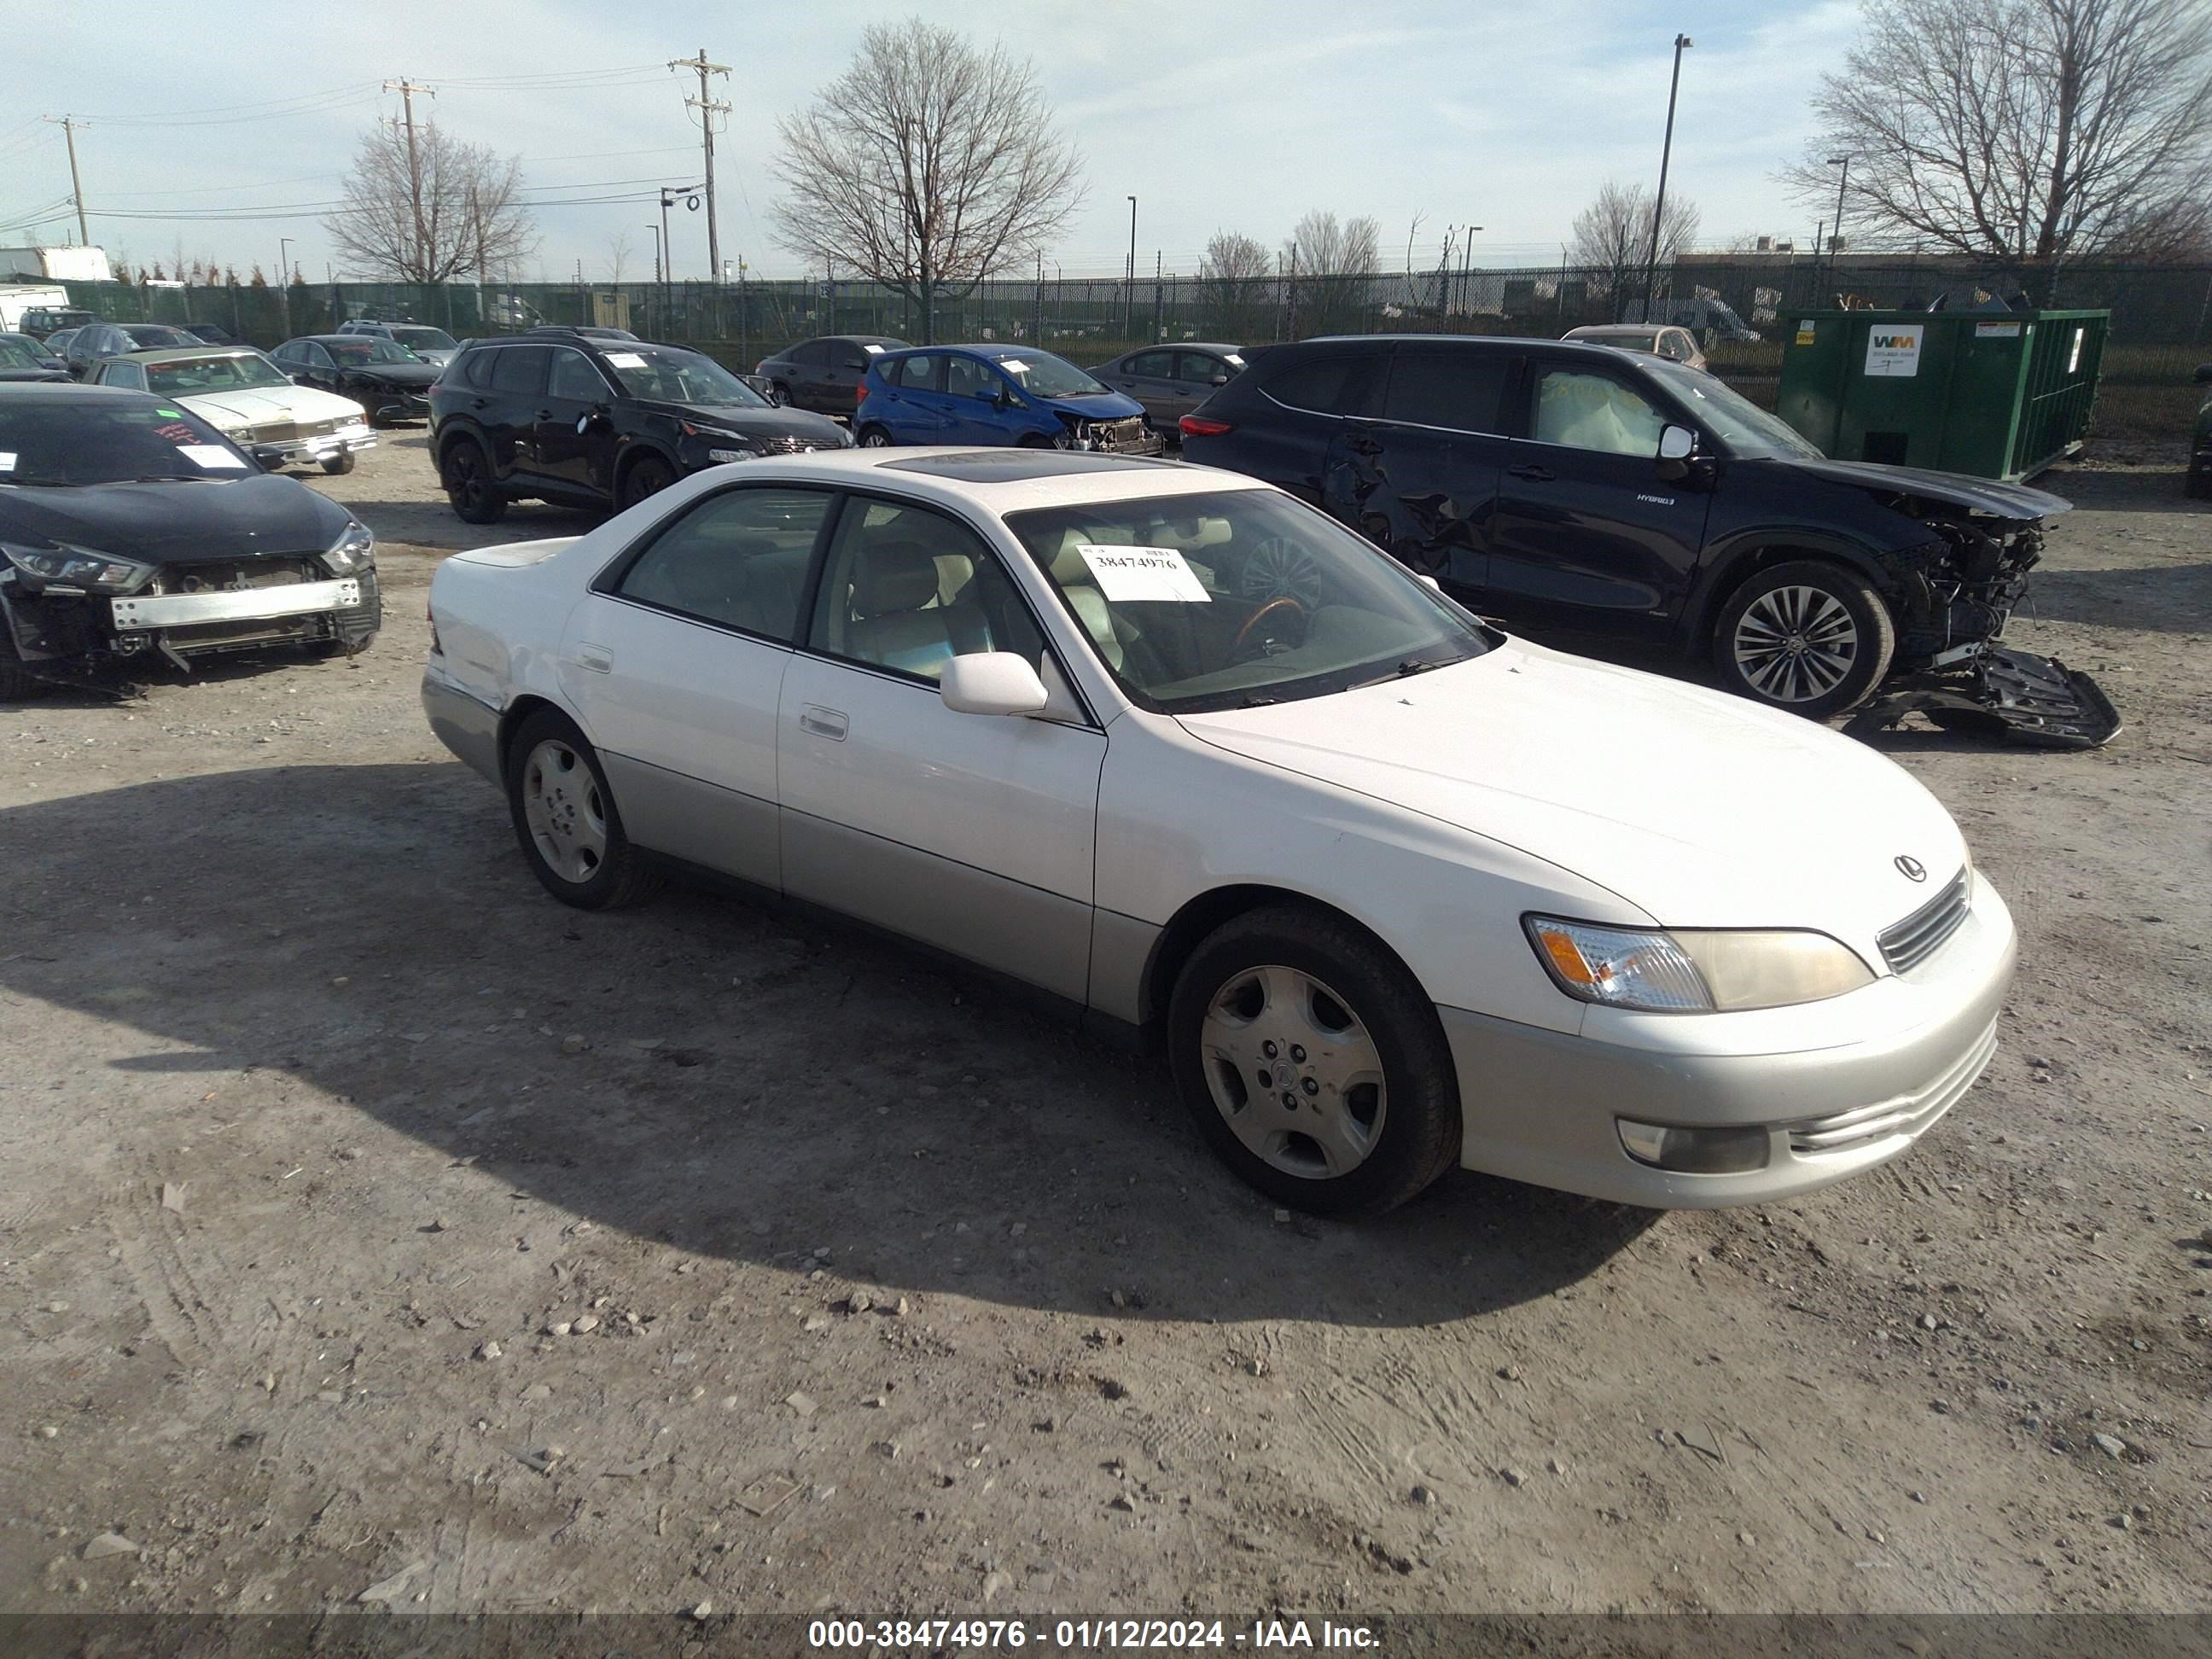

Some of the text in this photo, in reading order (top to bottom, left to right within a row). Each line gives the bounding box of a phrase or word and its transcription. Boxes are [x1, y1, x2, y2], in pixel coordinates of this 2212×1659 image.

[1873, 335, 1915, 349] WM
[1636, 493, 1669, 504] HYBRID
[1096, 556, 1178, 570] 38474976
